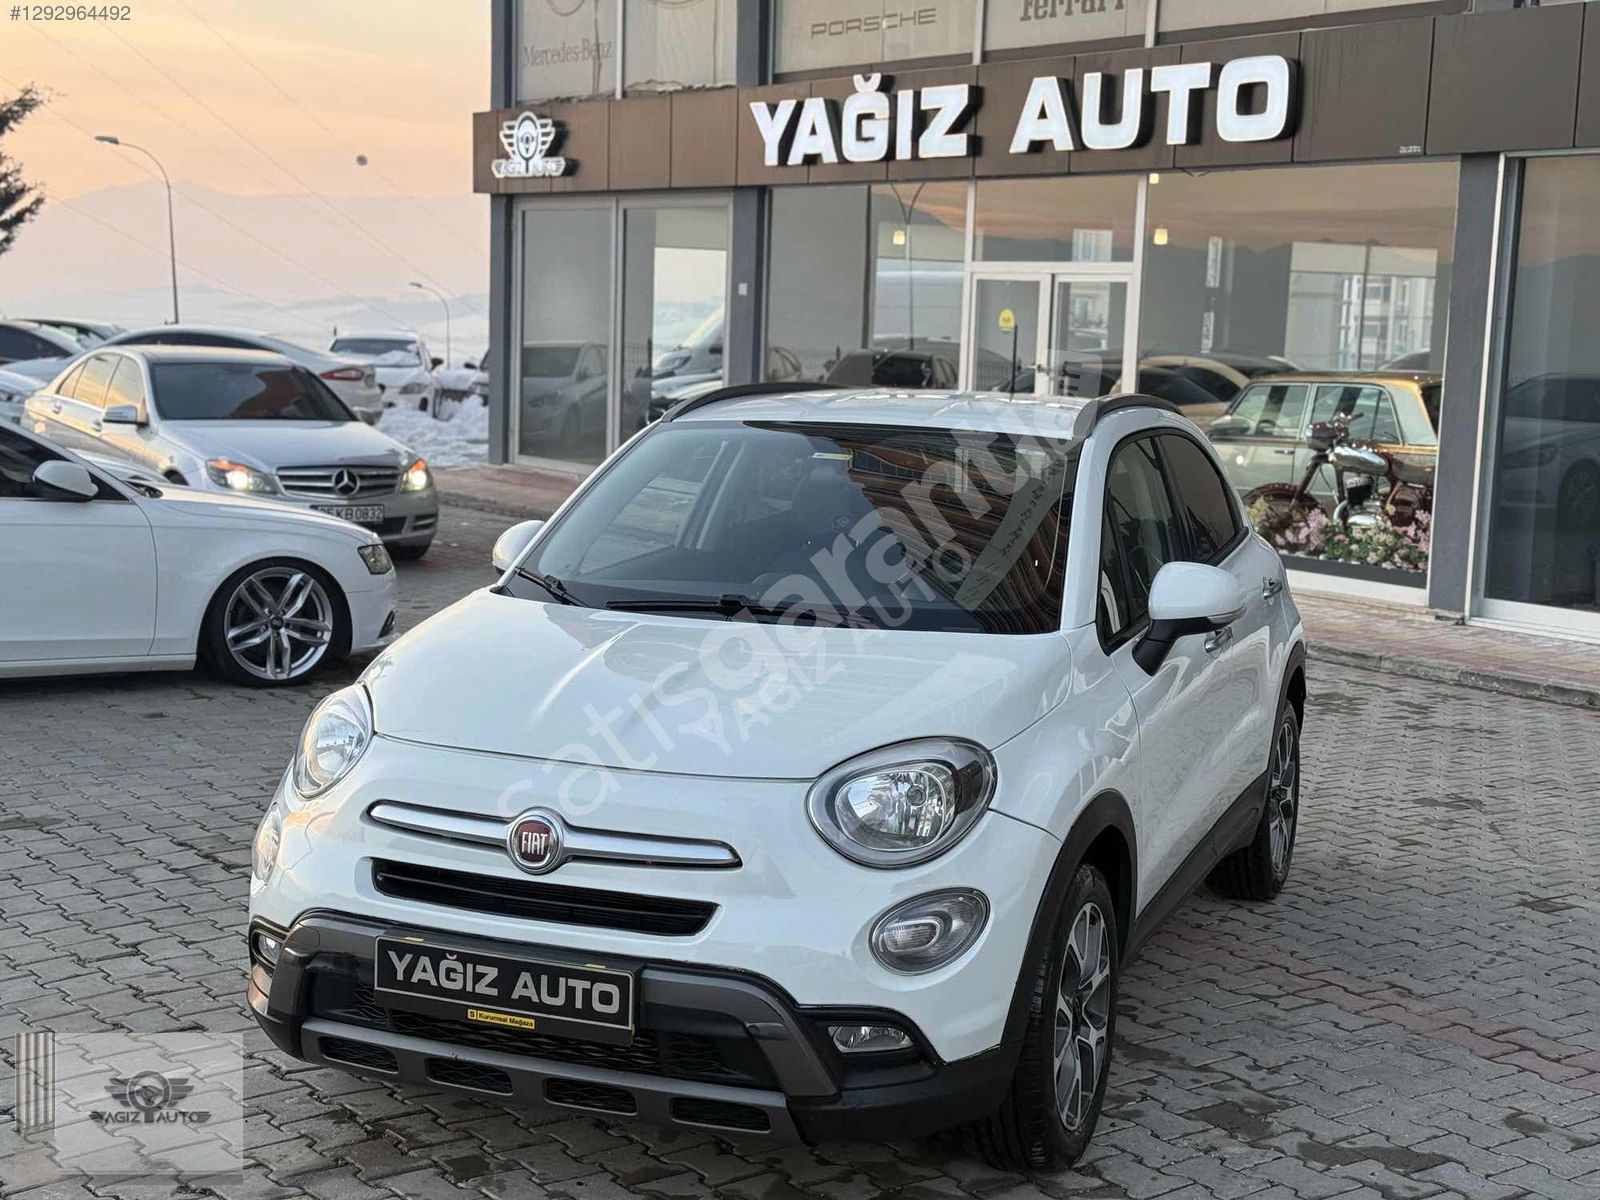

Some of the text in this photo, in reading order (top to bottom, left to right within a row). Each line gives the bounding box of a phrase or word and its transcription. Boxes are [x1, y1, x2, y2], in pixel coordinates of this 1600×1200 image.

[811, 8, 937, 38] PORSCHE
[749, 54, 1291, 168] YAĞIZ AUTO
[521, 831, 549, 855] FIAT
[387, 950, 620, 1015] YAĞIZ AUTO
